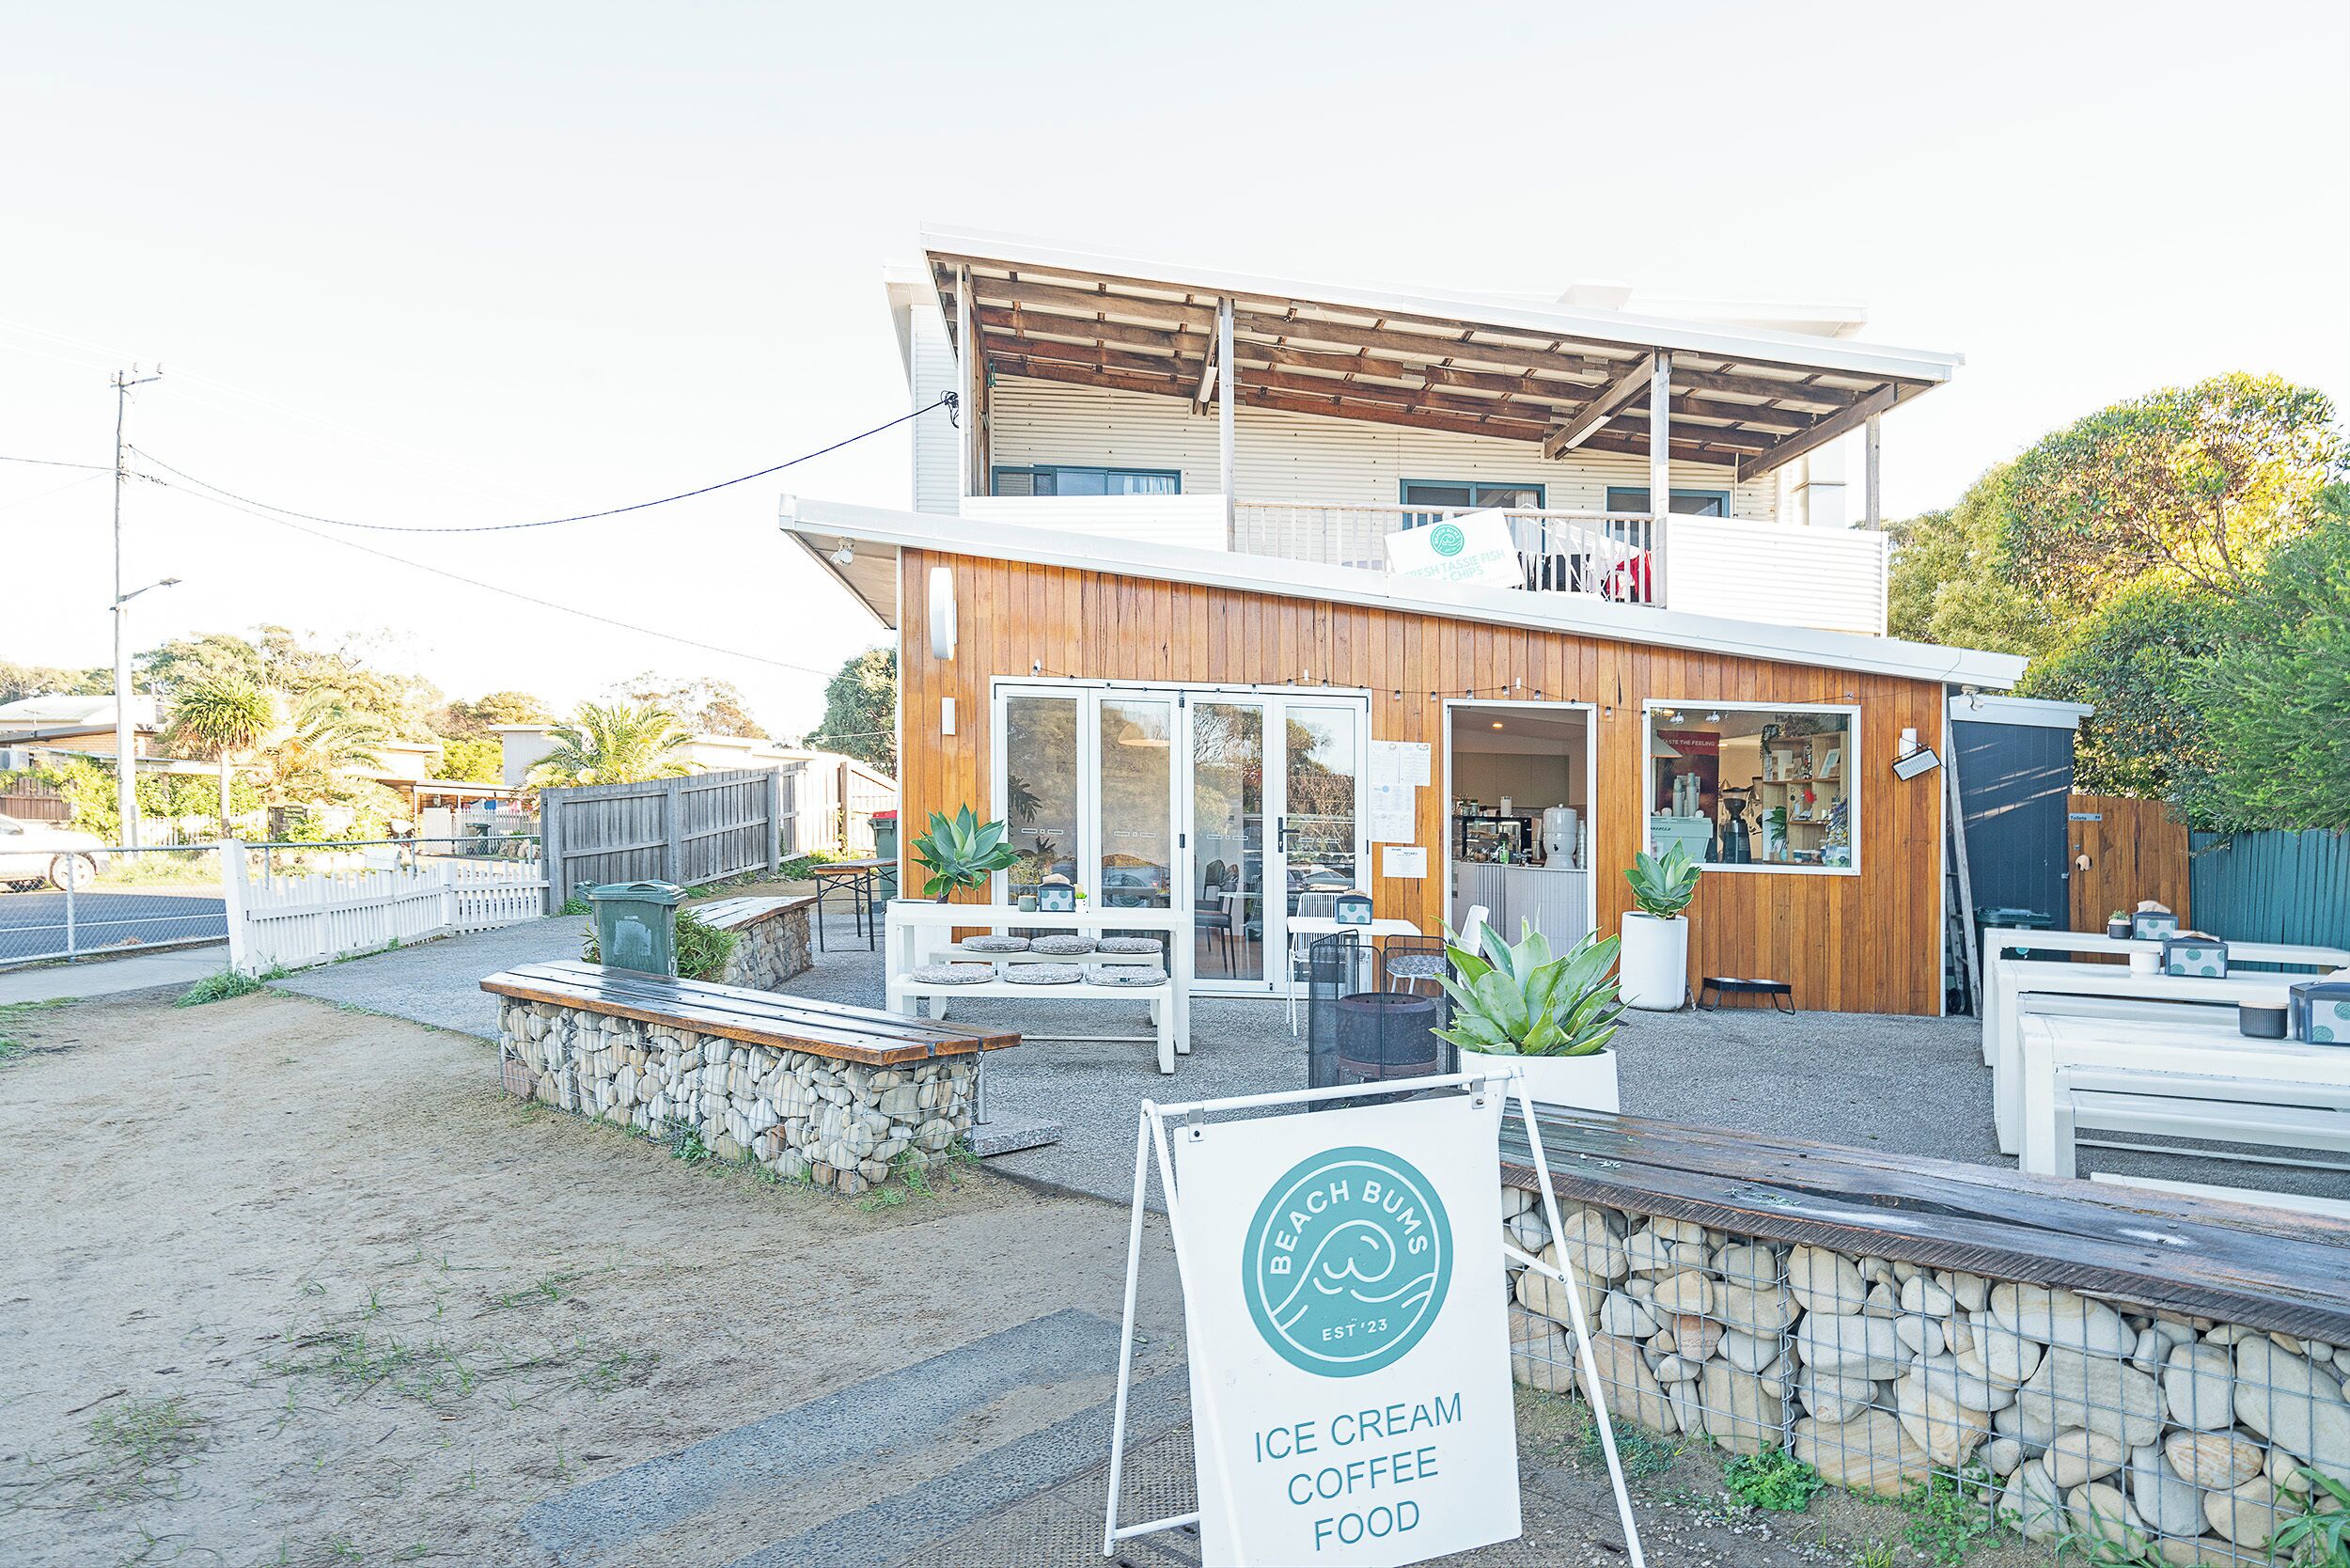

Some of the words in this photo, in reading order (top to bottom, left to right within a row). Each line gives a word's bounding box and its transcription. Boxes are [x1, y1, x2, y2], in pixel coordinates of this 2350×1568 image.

[1440, 555, 1480, 573] TASSIE
[1480, 548, 1506, 564] FISH
[1449, 565, 1484, 582] CHIPS
[1270, 1179, 1350, 1275] BEACH
[1361, 1180, 1429, 1256] BUMS
[1322, 1324, 1356, 1341] EST
[1360, 1318, 1388, 1334] '23
[1255, 1420, 1318, 1463] ICE
[1330, 1392, 1462, 1447] CREAM
[1288, 1446, 1438, 1505] COFFEE
[1314, 1500, 1419, 1551] FOOD
